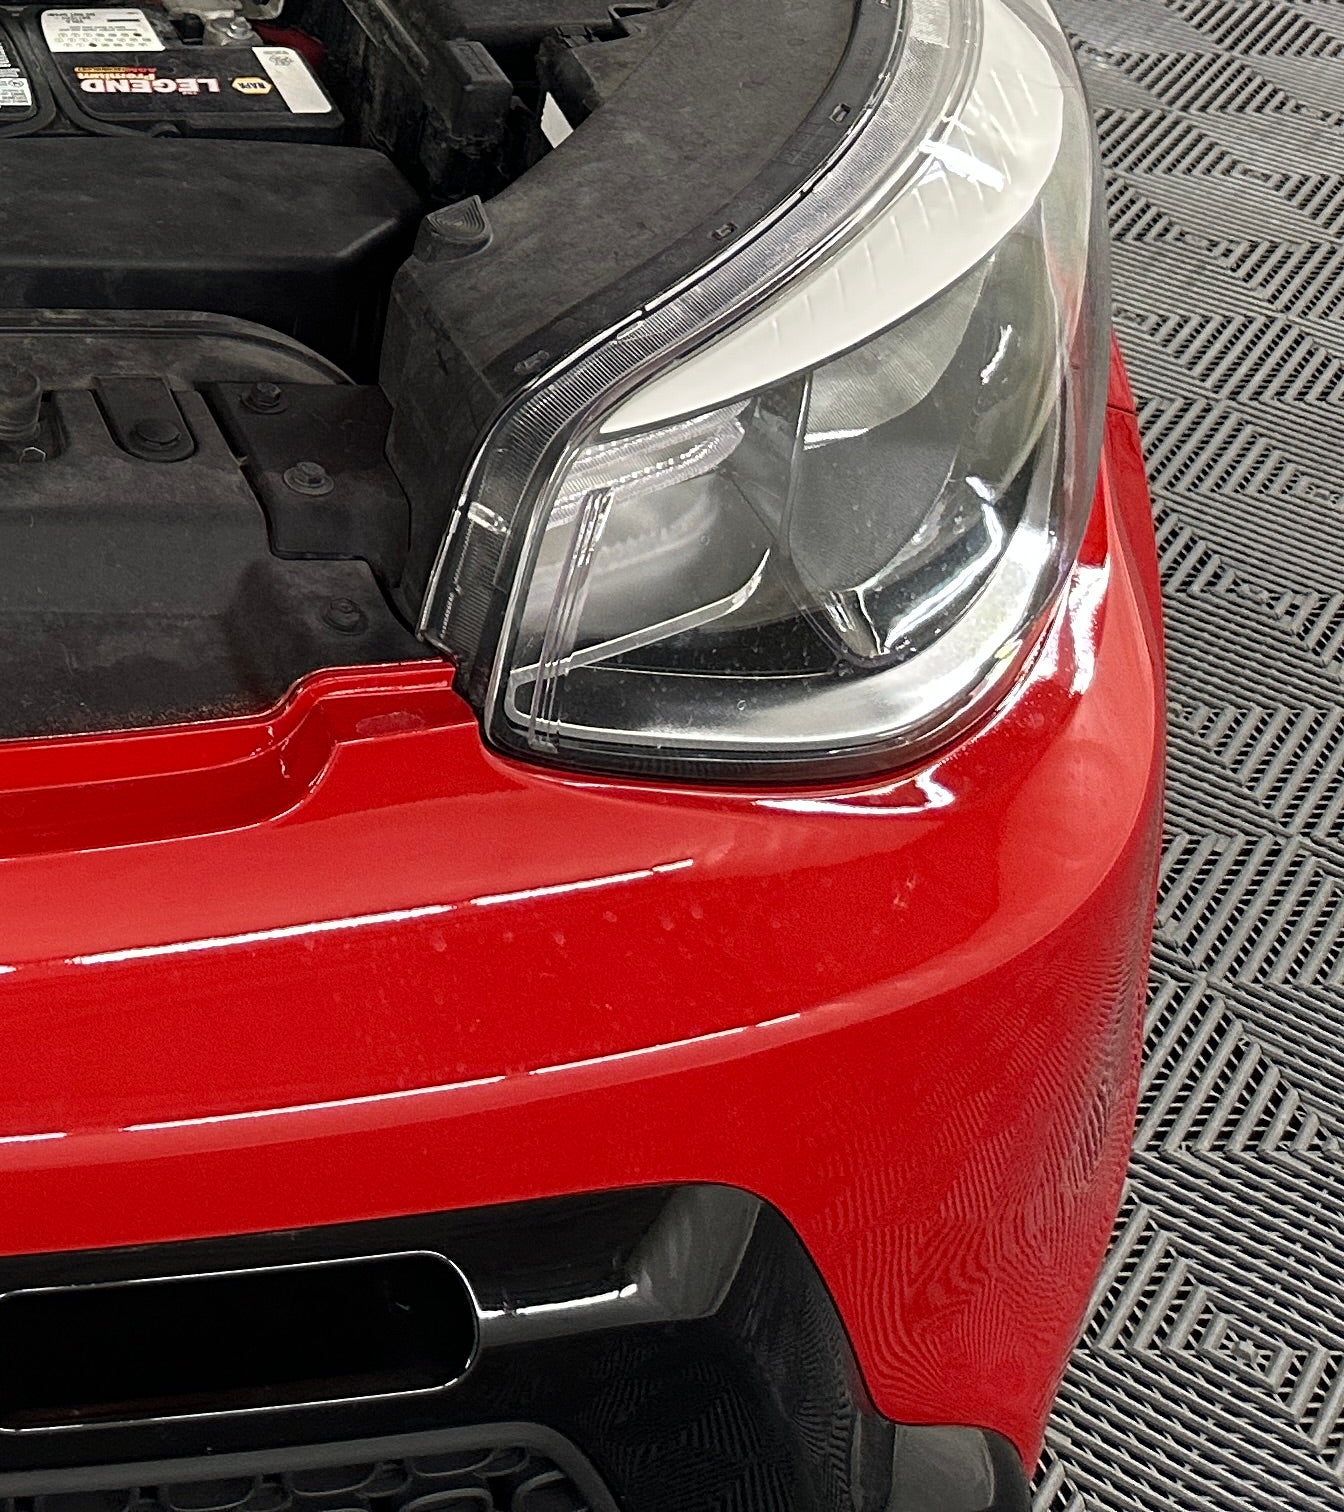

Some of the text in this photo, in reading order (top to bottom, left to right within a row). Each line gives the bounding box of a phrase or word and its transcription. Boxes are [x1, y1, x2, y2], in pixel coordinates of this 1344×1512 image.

[76, 73, 156, 81] Premium
[80, 78, 221, 93] LEGEND
[237, 82, 266, 90] NAPA
